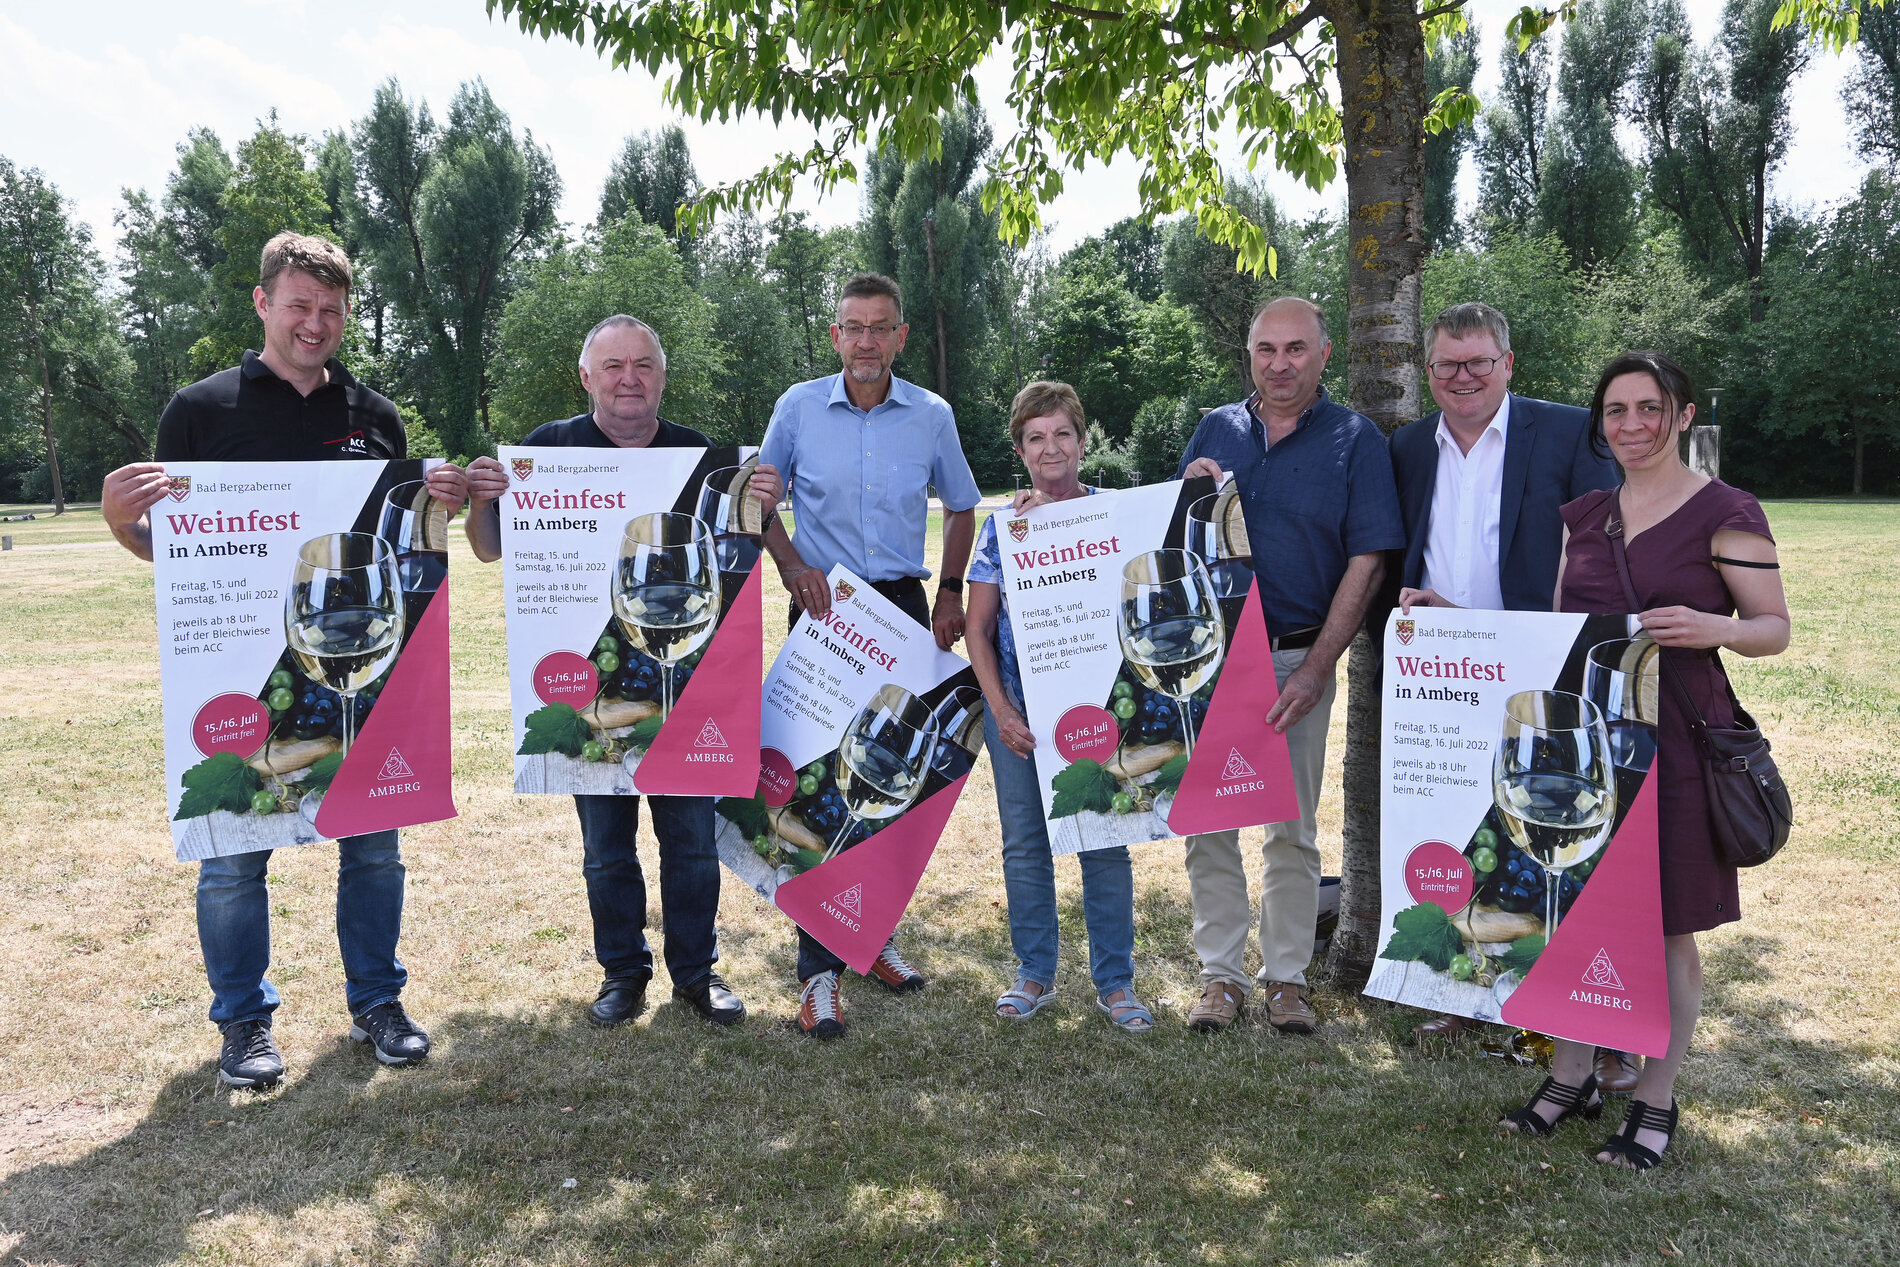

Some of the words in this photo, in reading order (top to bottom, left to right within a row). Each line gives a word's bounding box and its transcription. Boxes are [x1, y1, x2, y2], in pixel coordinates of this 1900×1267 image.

[350, 437, 366, 448] ACC
[538, 465, 555, 473] Bad
[558, 464, 619, 475] Bergzaberner
[196, 483, 216, 493] Bad
[220, 482, 291, 494] Bergzaberner
[511, 489, 626, 510] Weinfest
[166, 509, 300, 535] Weinfest
[513, 517, 530, 530] in
[534, 517, 597, 533] Amberg
[1032, 522, 1049, 532] Bad
[1050, 512, 1108, 529] Bergzaberner
[169, 544, 189, 558] in
[194, 541, 268, 557] Amberg
[515, 551, 546, 561] Freitag,
[549, 551, 560, 560] 15.
[562, 550, 579, 559] und
[1012, 536, 1121, 570] Weinfest
[515, 563, 553, 573] Samstag,
[556, 563, 567, 571] 16.
[569, 562, 583, 573] Juli
[586, 563, 606, 571] 2022
[171, 581, 209, 592] Freitag,
[212, 580, 224, 589] 15.
[228, 578, 246, 588] und
[1017, 578, 1033, 590] in
[1037, 568, 1097, 587] Amberg
[516, 582, 546, 593] jeweils
[548, 583, 558, 591] ab
[561, 583, 569, 591] 18
[572, 583, 587, 591] Uhr
[172, 595, 217, 605] Samstag,
[220, 592, 233, 602] 16.
[236, 591, 252, 603] Juli
[255, 589, 278, 600] 2022
[517, 594, 530, 603] auf
[533, 595, 547, 603] der
[549, 594, 598, 603] Bleichwiese
[518, 606, 539, 615] beim
[541, 606, 558, 614] ACC
[1022, 608, 1052, 619] Freitag,
[1054, 605, 1065, 613] 15.
[1067, 601, 1083, 611] und
[172, 617, 208, 631] jeweils
[210, 616, 223, 625] ab
[226, 615, 236, 624] 18
[239, 614, 257, 623] Uhr
[852, 597, 865, 611] Bad
[865, 607, 908, 642] Bergzaberner
[1024, 619, 1061, 631] Samstag,
[1062, 615, 1074, 624] 16.
[1075, 612, 1089, 624] Juli
[1090, 608, 1110, 619] 2022
[174, 631, 190, 642] auf
[193, 631, 209, 640] der
[213, 626, 270, 639] Bleichwiese
[817, 608, 898, 672] Weinfest
[1418, 628, 1435, 637] Bad
[1437, 628, 1496, 640] Bergzaberner
[174, 645, 200, 655] beim
[203, 643, 223, 653] ACC
[805, 623, 820, 640] in
[820, 636, 866, 675] Amberg
[1027, 639, 1056, 653] jeweils
[1057, 637, 1068, 646] ab
[1069, 635, 1078, 643] 18
[1080, 633, 1095, 642] Uhr
[1029, 652, 1042, 663] auf
[1044, 651, 1058, 660] der
[1060, 643, 1108, 657] Bleichwiese
[790, 650, 816, 672] Freitag,
[818, 667, 826, 677] 15.
[827, 674, 842, 686] und
[1031, 664, 1052, 674] beim
[1054, 660, 1070, 670] ACC
[1395, 655, 1506, 682] Weinfest
[543, 672, 571, 684] 15./16.
[573, 670, 588, 682] Juli
[785, 660, 814, 684] Samstag,
[817, 680, 826, 690] 16.
[826, 686, 840, 697] Juli
[839, 694, 856, 709] 2022
[549, 686, 572, 694] Eintritt
[573, 684, 586, 693] frei!
[774, 675, 799, 696] jeweils
[799, 693, 809, 702] ab
[810, 699, 819, 707] 18
[818, 703, 832, 716] Uhr
[1396, 684, 1412, 699] in
[1416, 686, 1479, 706] Amberg
[767, 695, 783, 711] beim
[782, 708, 798, 721] ACC
[771, 687, 783, 697] auf
[782, 695, 795, 705] der
[794, 702, 835, 731] Bleichwiese
[204, 718, 238, 733] 15./16.
[240, 712, 258, 727] Juli
[1394, 722, 1426, 734] Freitag,
[1429, 724, 1440, 733] 15.
[1443, 725, 1460, 735] und
[212, 732, 238, 743] Eintritt
[240, 728, 255, 740] frei!
[1064, 727, 1092, 742] 15./16.
[1093, 721, 1108, 736] Juli
[1071, 740, 1094, 751] Eintritt
[1094, 736, 1107, 747] frei!
[1394, 735, 1433, 748] Samstag,
[1435, 738, 1447, 747] 16.
[1449, 739, 1463, 750] Juli
[1466, 740, 1488, 750] 2022
[685, 753, 734, 763] AMBERG
[1393, 757, 1423, 769] jeweils
[1425, 760, 1436, 770] ab
[1439, 762, 1447, 771] 18
[1450, 762, 1467, 772] Uhr
[776, 775, 790, 787] Juli
[1393, 771, 1407, 780] auf
[1409, 772, 1424, 782] der
[1426, 774, 1478, 787] Bleichwiese
[369, 782, 420, 798] AMBERG
[1215, 780, 1264, 797] AMBERG
[1393, 784, 1414, 795] beim
[1417, 787, 1434, 797] ACC
[1415, 867, 1444, 879] 15./16.
[1446, 868, 1463, 880] Juli
[1421, 883, 1444, 892] Eintritt
[1445, 883, 1459, 894] frei!
[820, 901, 860, 932] AMBERG
[1569, 990, 1632, 1010] AMBERG
